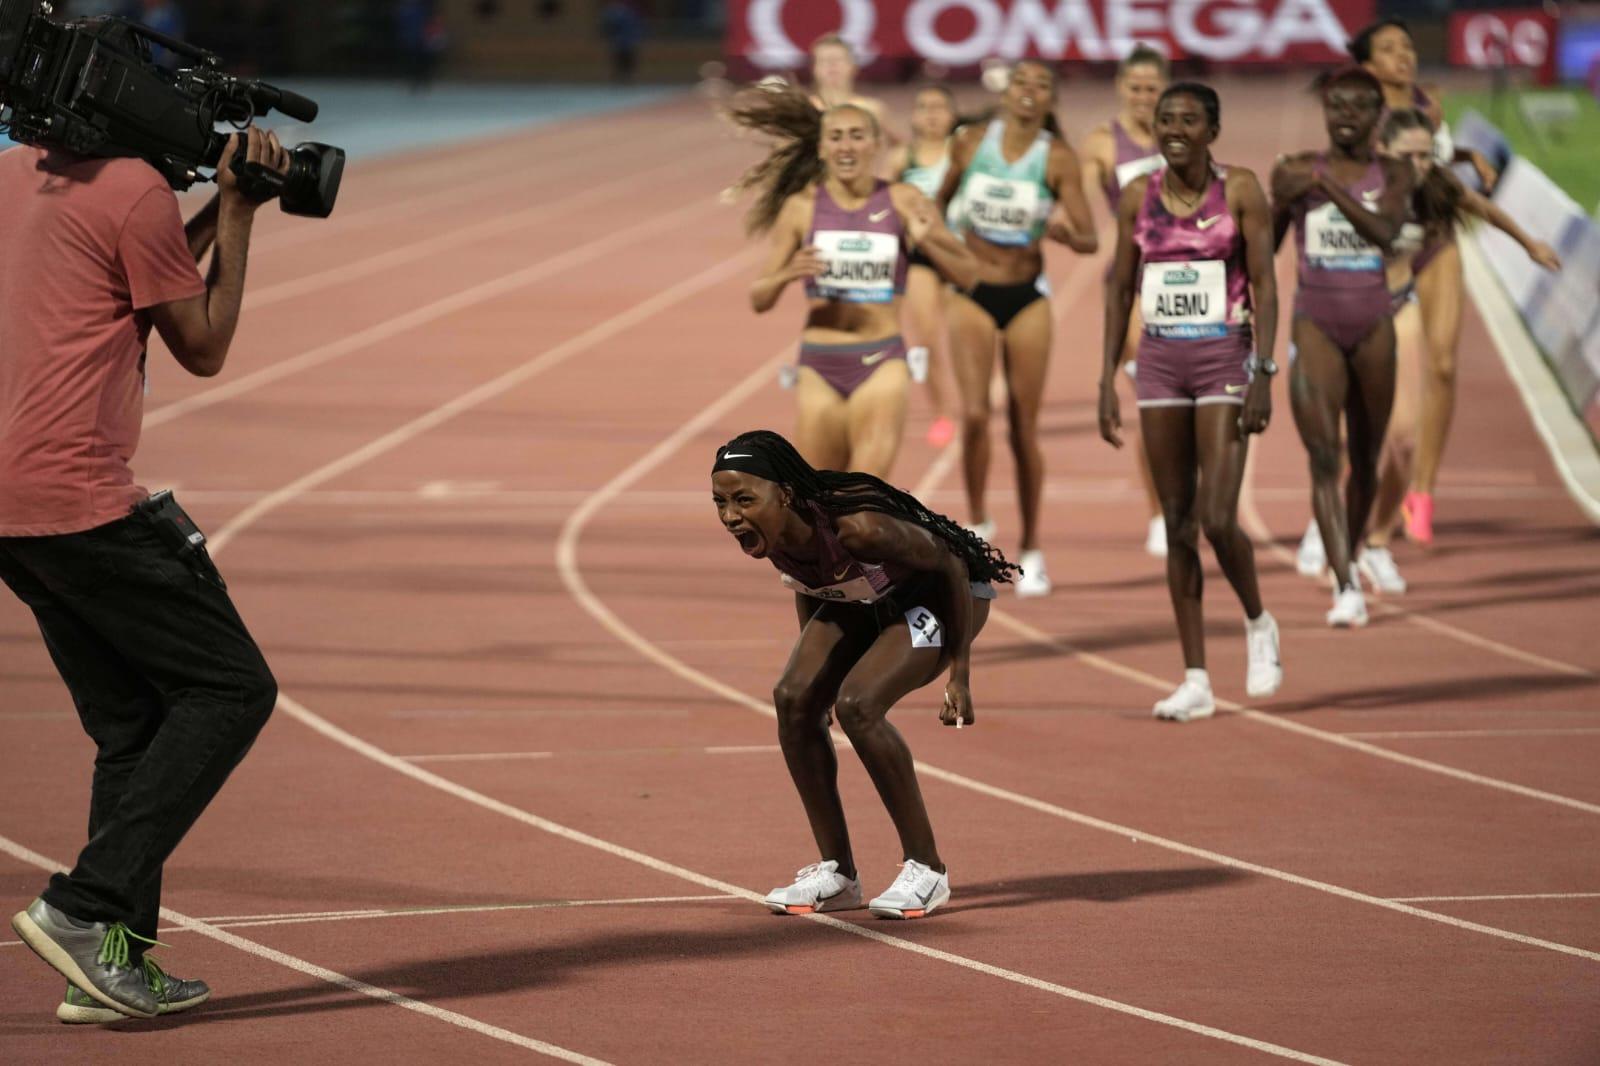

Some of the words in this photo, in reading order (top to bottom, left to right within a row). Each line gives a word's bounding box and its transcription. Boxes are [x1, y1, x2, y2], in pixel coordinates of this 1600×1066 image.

[904, 0, 1351, 66] OMEGA
[819, 260, 892, 281] AJANOVA
[1155, 291, 1209, 317] ALEMU
